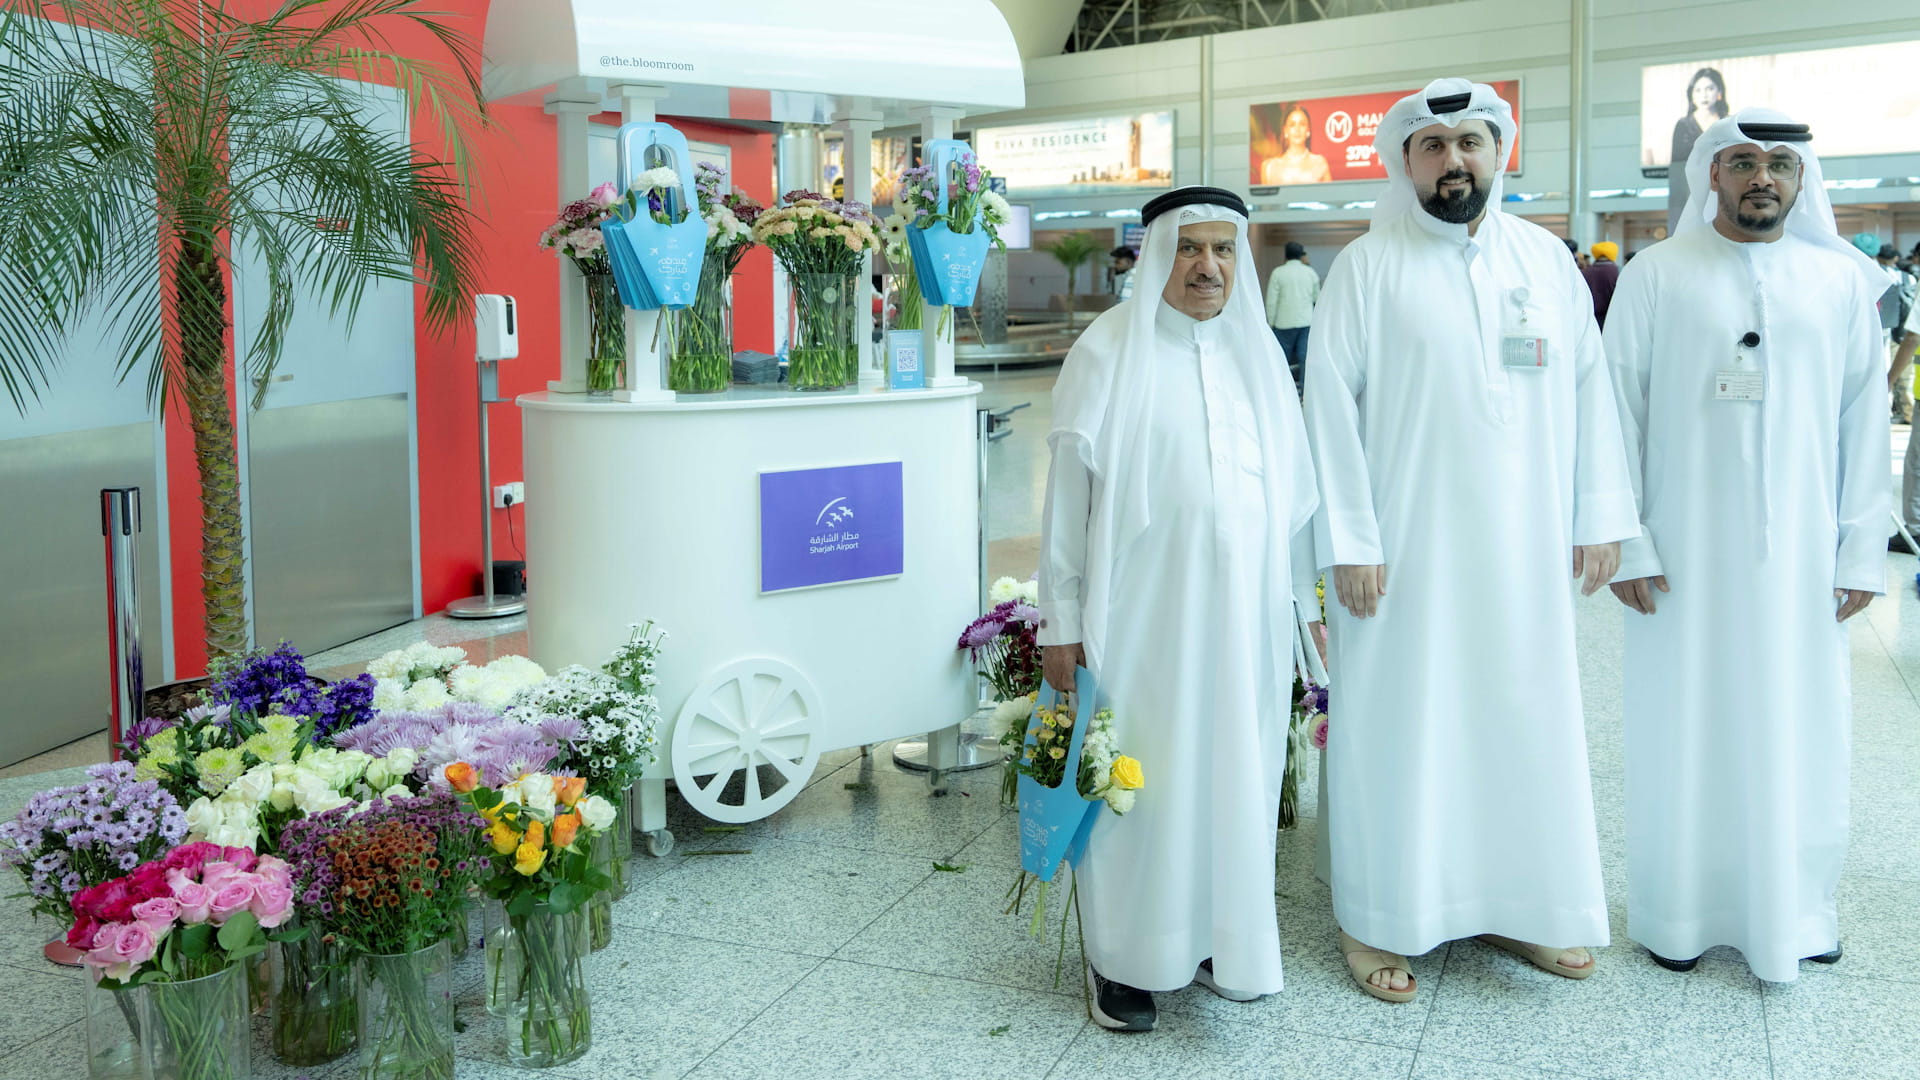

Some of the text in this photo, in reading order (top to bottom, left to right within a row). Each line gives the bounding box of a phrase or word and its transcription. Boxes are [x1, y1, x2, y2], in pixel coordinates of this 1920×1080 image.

[600, 55, 695, 71] @the.bloomroom
[1032, 132, 1106, 147] RESIDENCE
[810, 531, 859, 544] مطار الشارقة
[810, 542, 859, 554] Sharjah Airport
